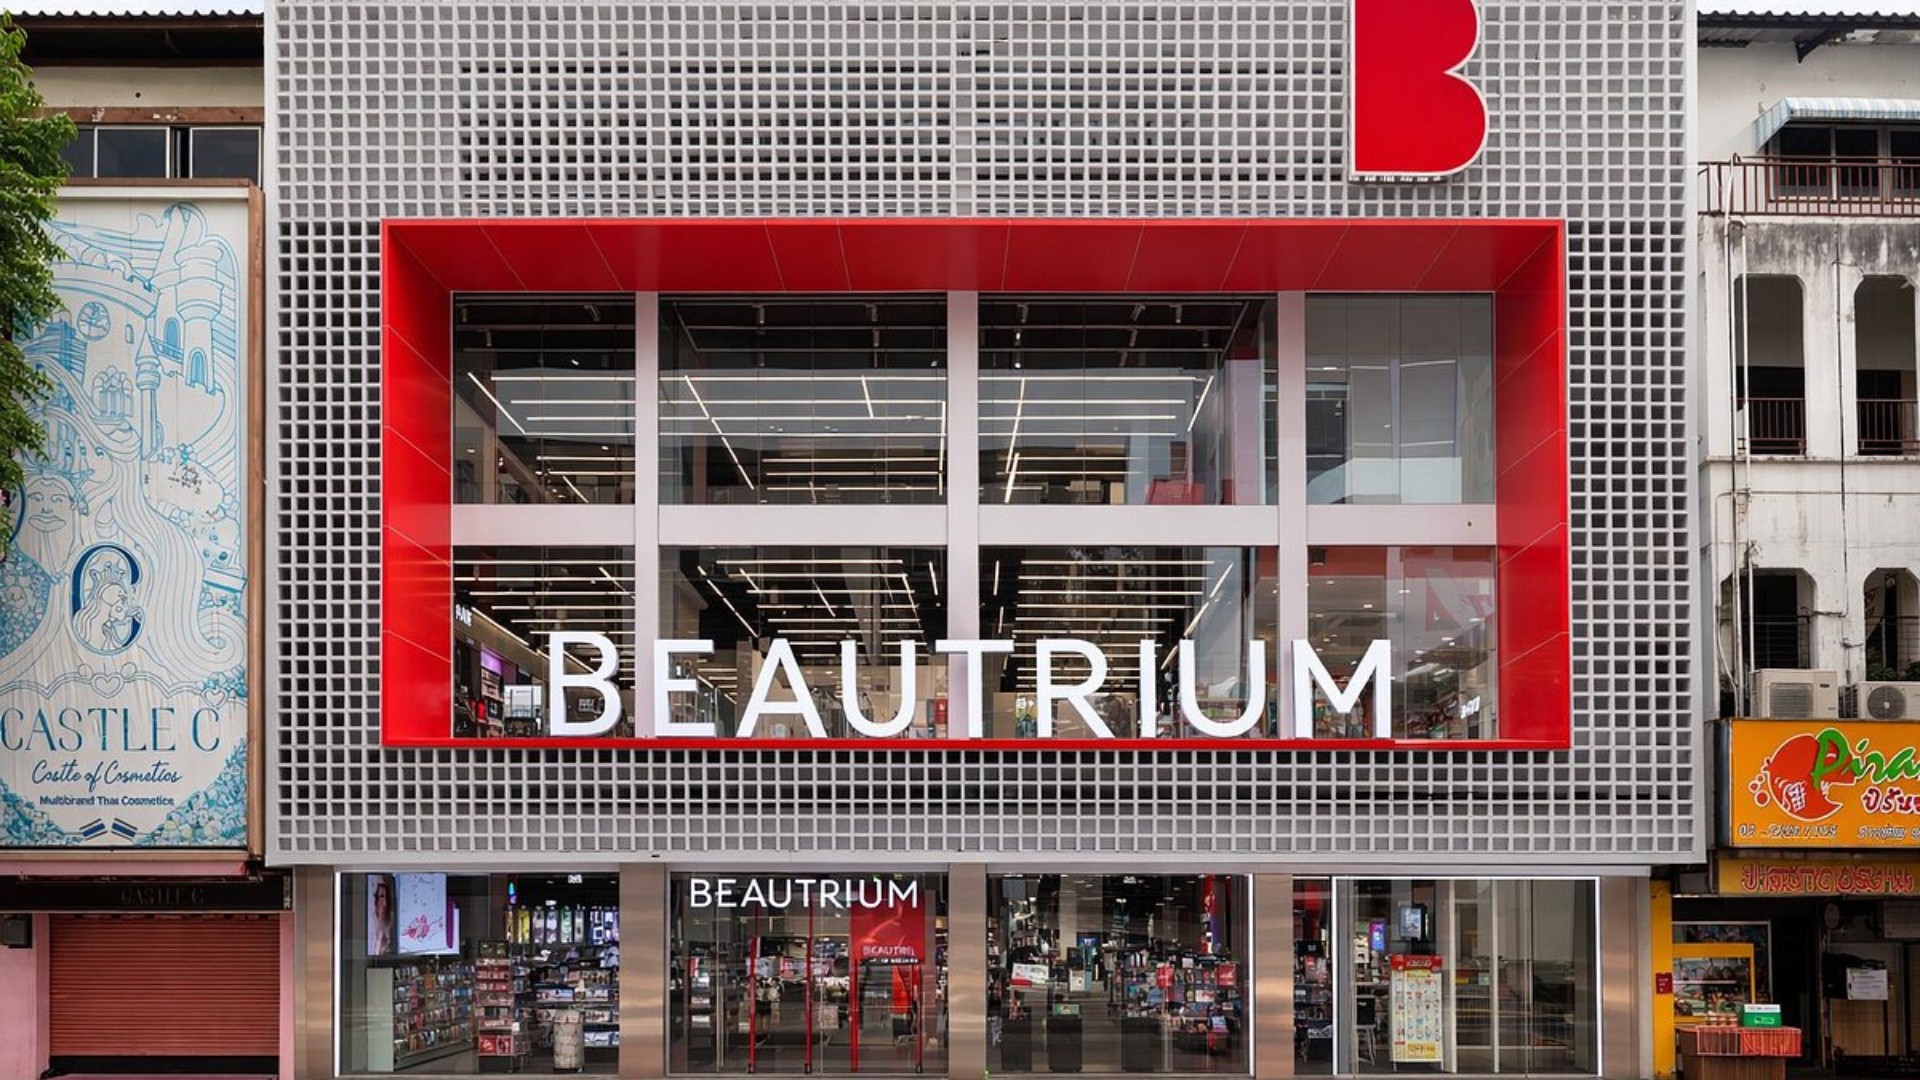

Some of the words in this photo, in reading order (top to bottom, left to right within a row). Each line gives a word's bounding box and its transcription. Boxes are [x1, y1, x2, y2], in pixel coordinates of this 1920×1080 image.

[1350, 0, 1489, 176] B
[549, 632, 1390, 739] BEAUTRIUM
[1, 707, 176, 751] CASTLE
[192, 707, 220, 751] C
[32, 759, 81, 784] Castle
[84, 761, 103, 792] of
[104, 760, 182, 784] Cosmetics
[40, 796, 95, 805] Multibrand
[97, 796, 118, 805] Thai
[121, 796, 174, 805] Cosmetics
[690, 878, 918, 908] BEAUTRIUM
